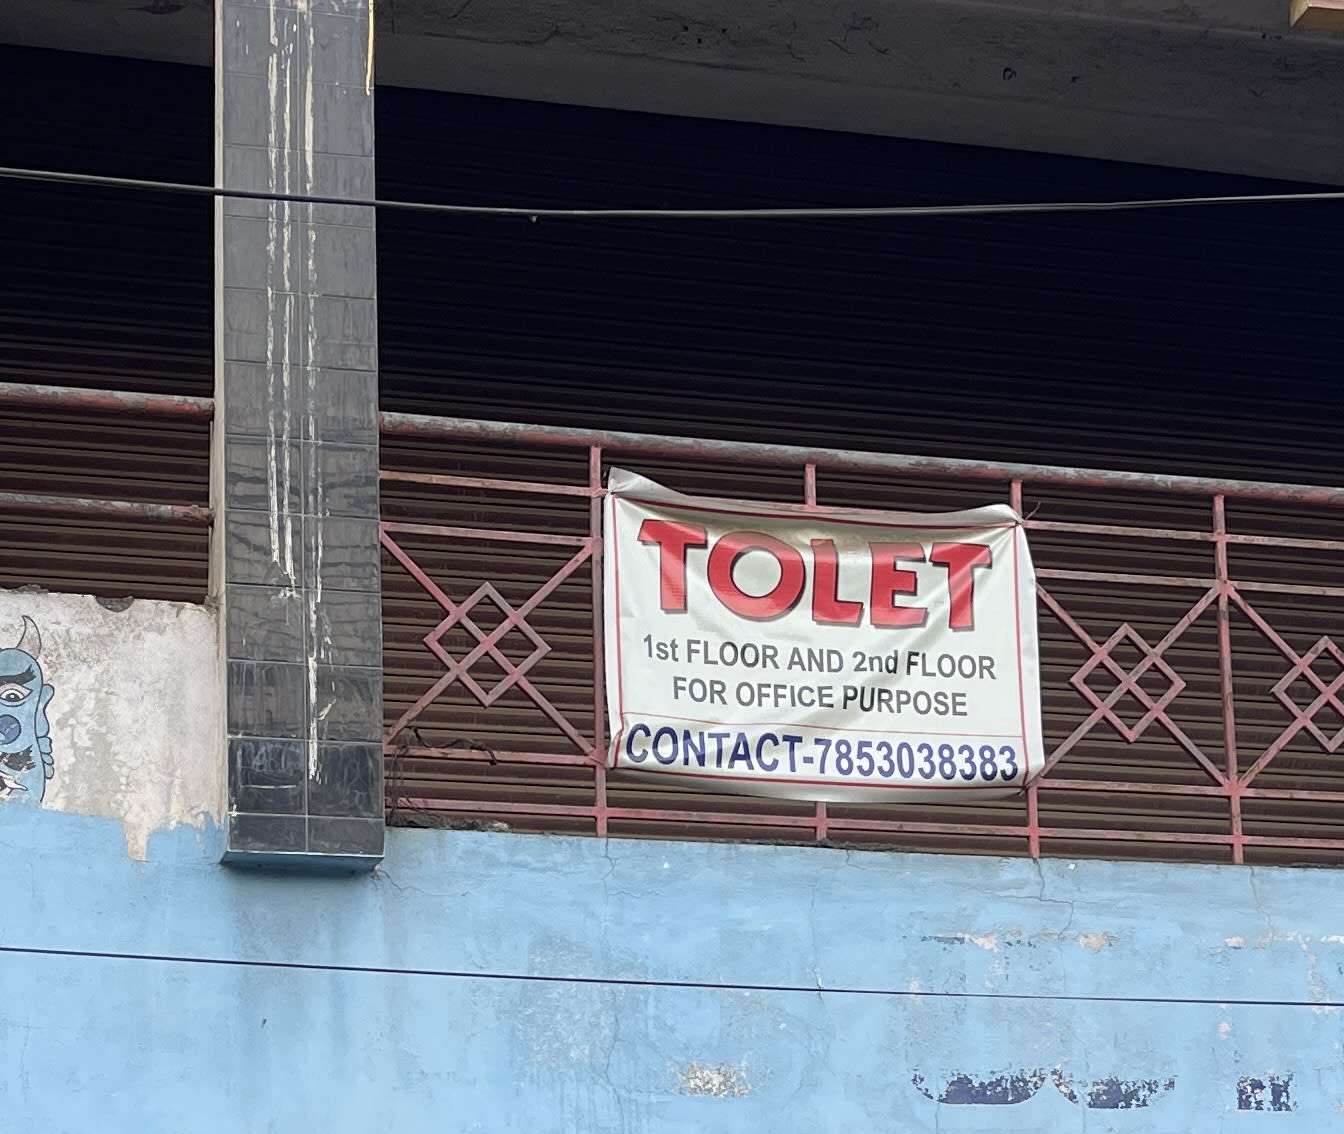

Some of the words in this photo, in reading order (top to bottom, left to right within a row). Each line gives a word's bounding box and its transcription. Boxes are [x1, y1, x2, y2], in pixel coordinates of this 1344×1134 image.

[637, 519, 993, 632] TOLET
[643, 633, 679, 663] 1st
[687, 639, 780, 671] FLOOR
[787, 648, 844, 673] AND
[853, 650, 898, 675] 2nd
[906, 652, 997, 681] FLOOR
[673, 676, 726, 706] FOR
[736, 682, 834, 709] OFFICE
[842, 685, 968, 716] PURPOSE
[625, 723, 1019, 783] CONTACT-7853038383
